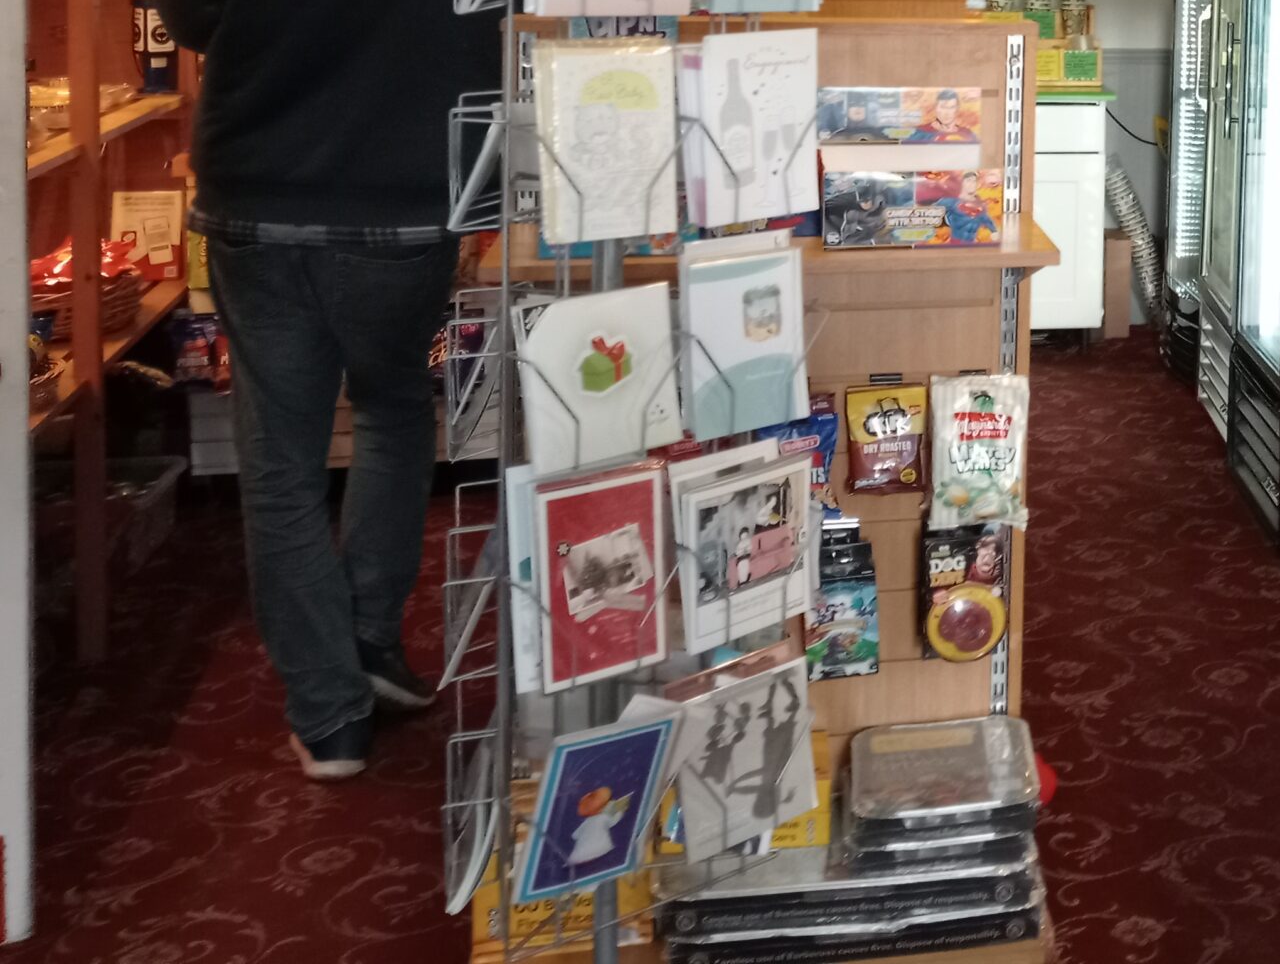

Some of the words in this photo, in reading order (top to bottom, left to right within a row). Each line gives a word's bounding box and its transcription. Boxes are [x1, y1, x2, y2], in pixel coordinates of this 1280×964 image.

[863, 443, 878, 455] DRY
[880, 440, 912, 453] ROASTED
[930, 556, 966, 574] DOG
